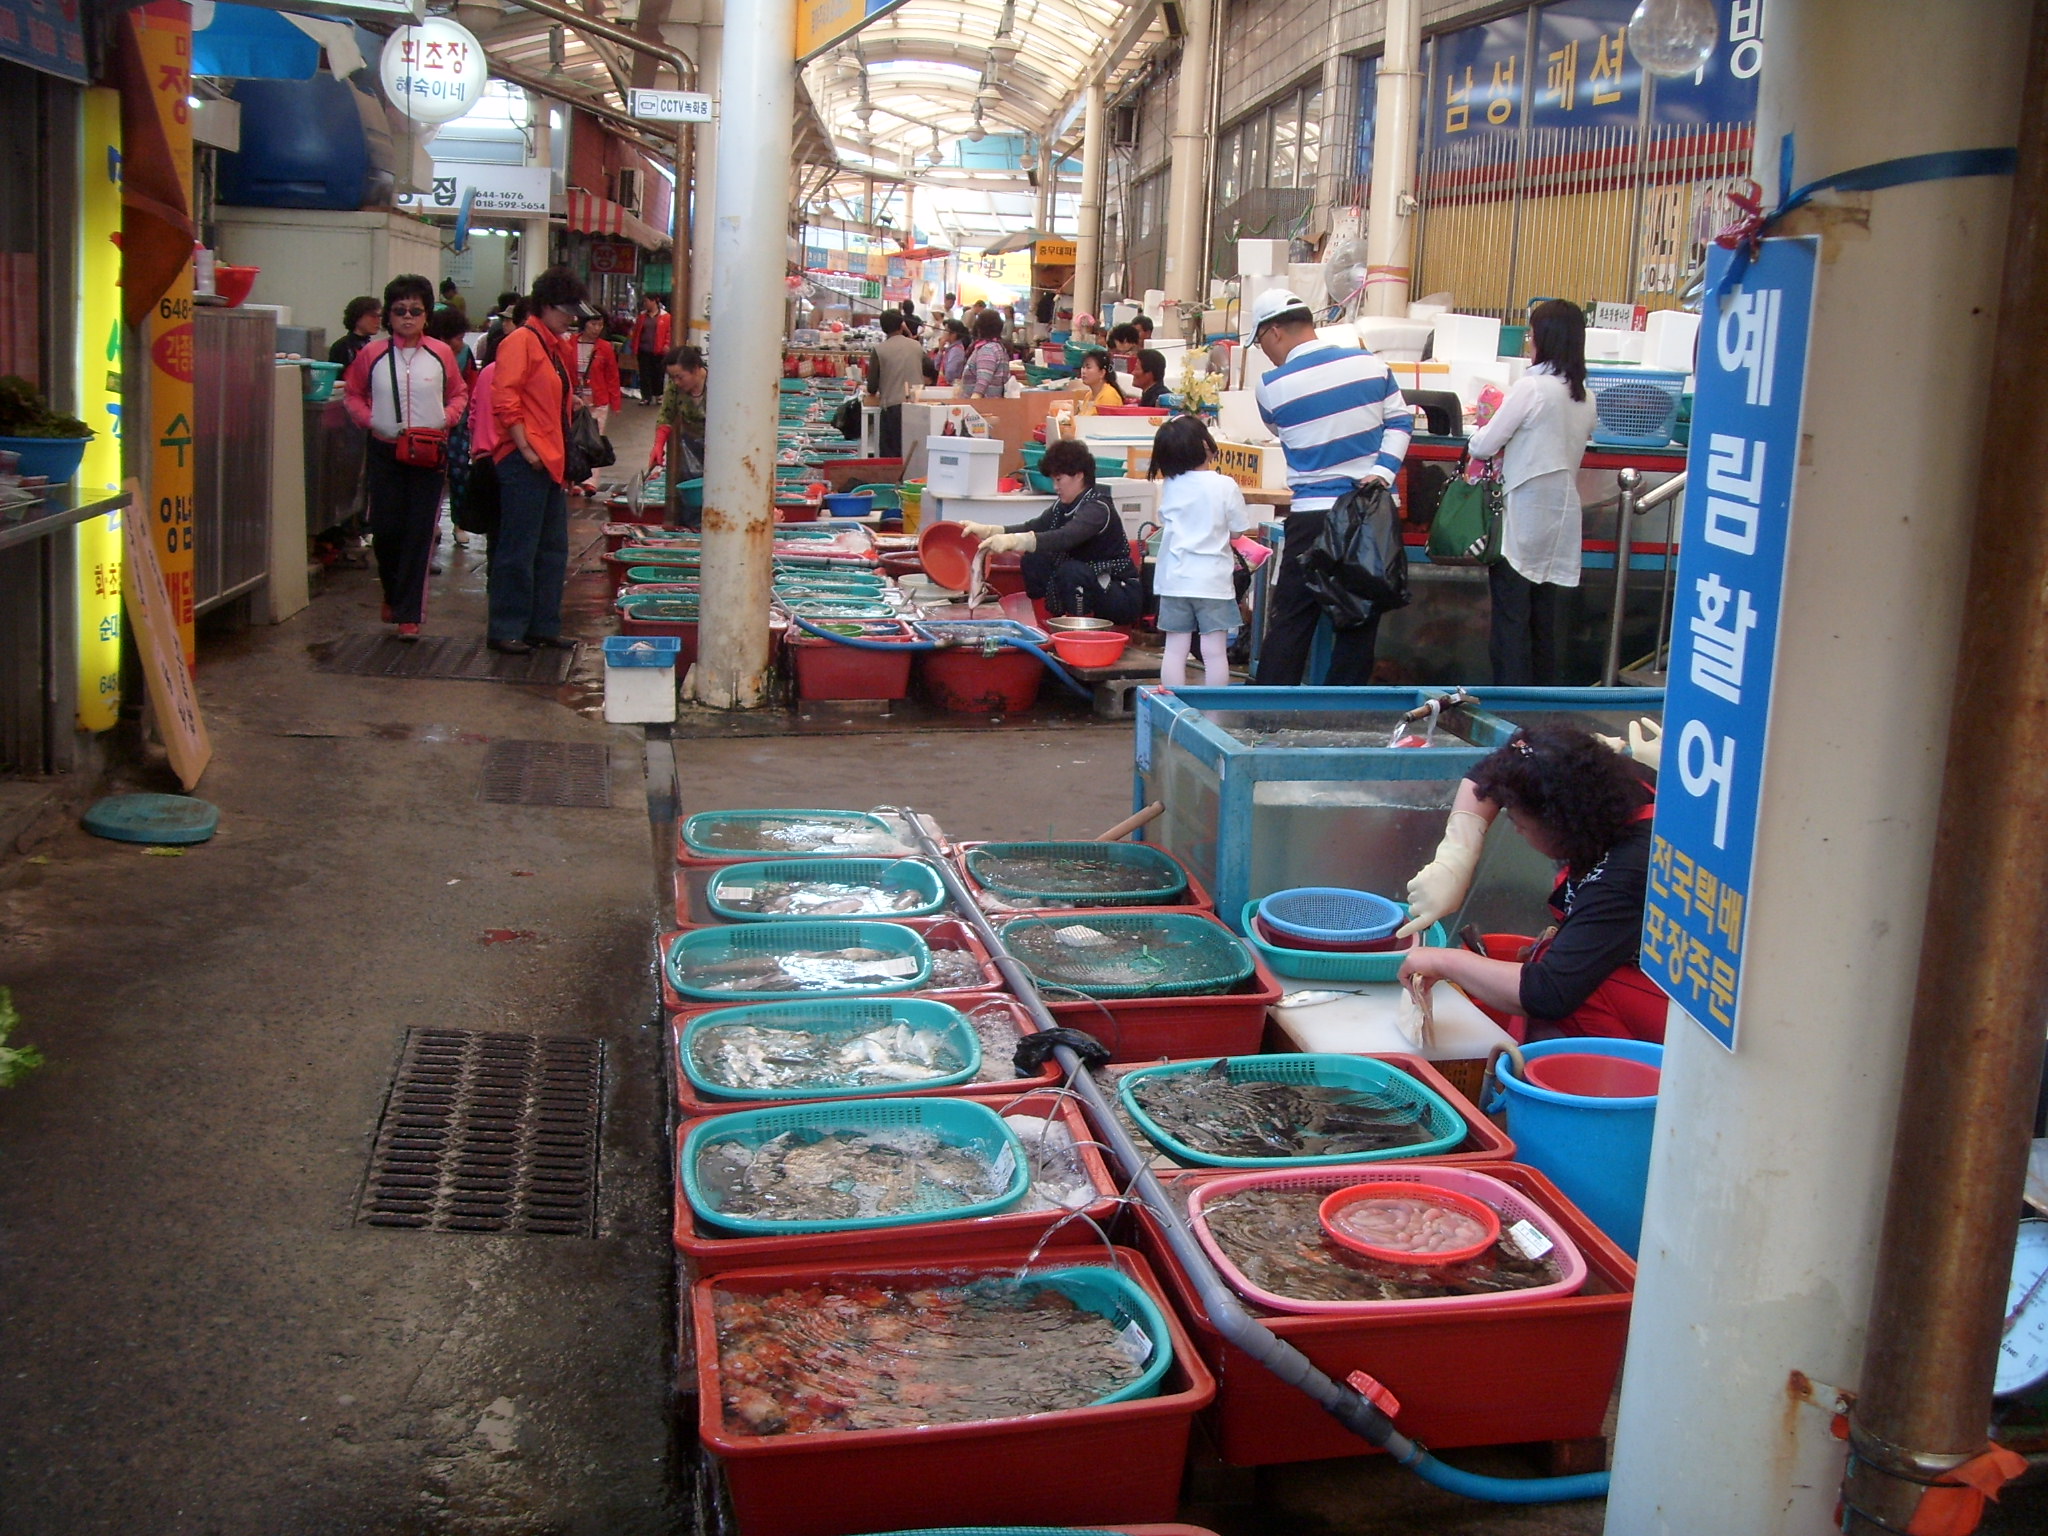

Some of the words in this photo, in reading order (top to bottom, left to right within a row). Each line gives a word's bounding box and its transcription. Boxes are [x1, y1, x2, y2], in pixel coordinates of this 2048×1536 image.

[400, 39, 468, 74] 회초장
[1446, 55, 1516, 133] 남성
[1545, 27, 1627, 111] 패션
[475, 199, 546, 210] 018-592-5654
[160, 412, 193, 468] 수
[1677, 283, 1782, 850] 혜림활어
[1652, 834, 1744, 955] 전국택배
[1643, 906, 1737, 1028] 포장주문
